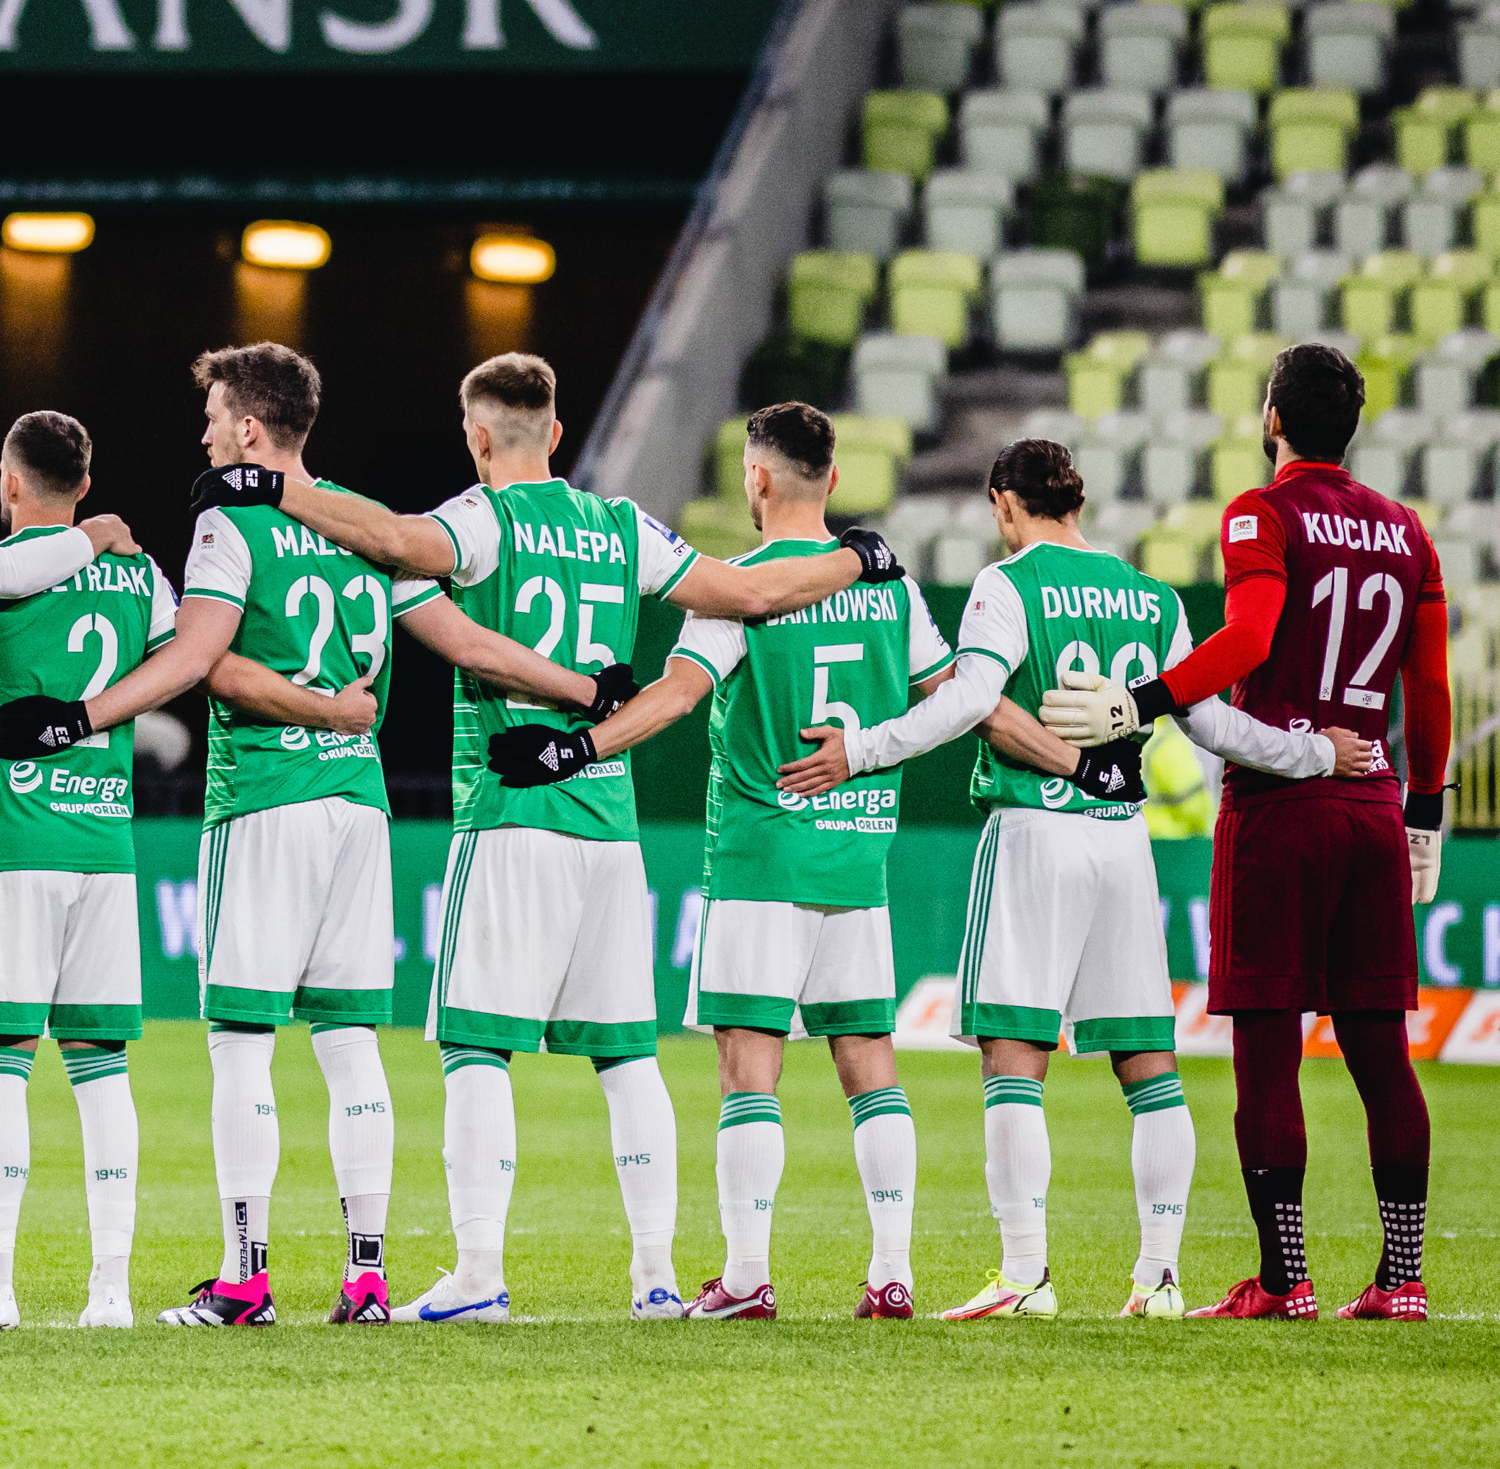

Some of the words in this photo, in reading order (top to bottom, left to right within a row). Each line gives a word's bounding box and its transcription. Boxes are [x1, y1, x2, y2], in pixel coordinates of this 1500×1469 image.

[271, 525, 354, 558] MAL
[513, 521, 627, 565] NALEPA
[1302, 512, 1412, 557] KUCIAK
[1041, 586, 1161, 625] DURMUS
[285, 574, 388, 698] 23
[507, 575, 624, 710] 25
[1312, 567, 1404, 711] 12
[67, 612, 118, 749] 2
[1134, 674, 1151, 686] BU1
[811, 643, 864, 742] 5
[1110, 704, 1124, 731] 12
[356, 745, 375, 757] ORL
[589, 763, 623, 776] ORLEN
[50, 768, 128, 802] Energa
[50, 802, 93, 814] GRUPA
[93, 805, 128, 816] ORLEN
[812, 789, 896, 815] Energa
[1084, 805, 1126, 818] GRUPA
[815, 819, 856, 831] GRUPA
[858, 820, 893, 830] ORLEN
[255, 1104, 277, 1115] 194
[345, 1102, 385, 1117] 1945
[616, 1153, 650, 1167] 1945
[96, 1168, 128, 1180] 1945
[754, 1199, 774, 1211] 194
[871, 1190, 904, 1203] 1945
[1152, 1204, 1183, 1215] 1945
[238, 1227, 248, 1284] TAPEDESI
